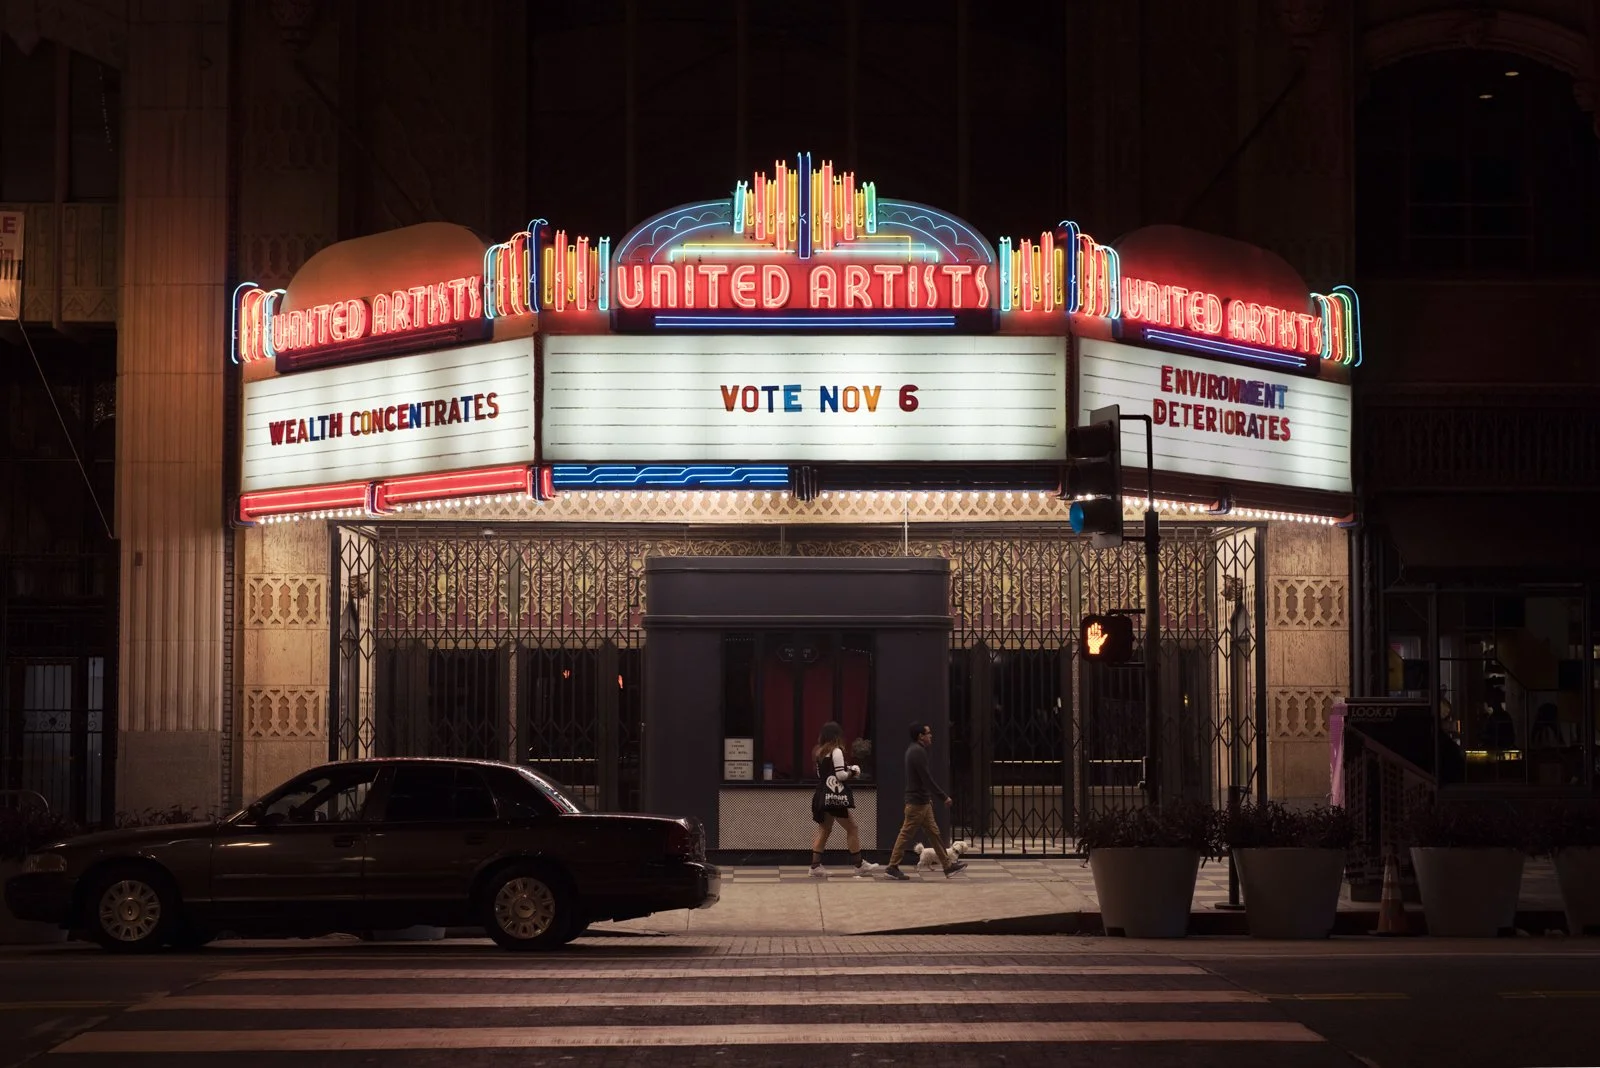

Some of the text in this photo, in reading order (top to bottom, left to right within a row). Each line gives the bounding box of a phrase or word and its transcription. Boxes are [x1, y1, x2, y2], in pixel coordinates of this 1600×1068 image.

[0, 216, 17, 233] E
[617, 265, 990, 308] UNITED ARTISTS
[272, 276, 480, 353] UNITED ARTISTS
[1122, 278, 1321, 354] UNITED ARTISTS
[720, 384, 919, 413] VOTE NOV 6
[1161, 365, 1288, 409] ENVIRONMENT
[269, 392, 499, 446] WEALTH CONCENTRATES
[1153, 398, 1291, 441] DETERIORATES
